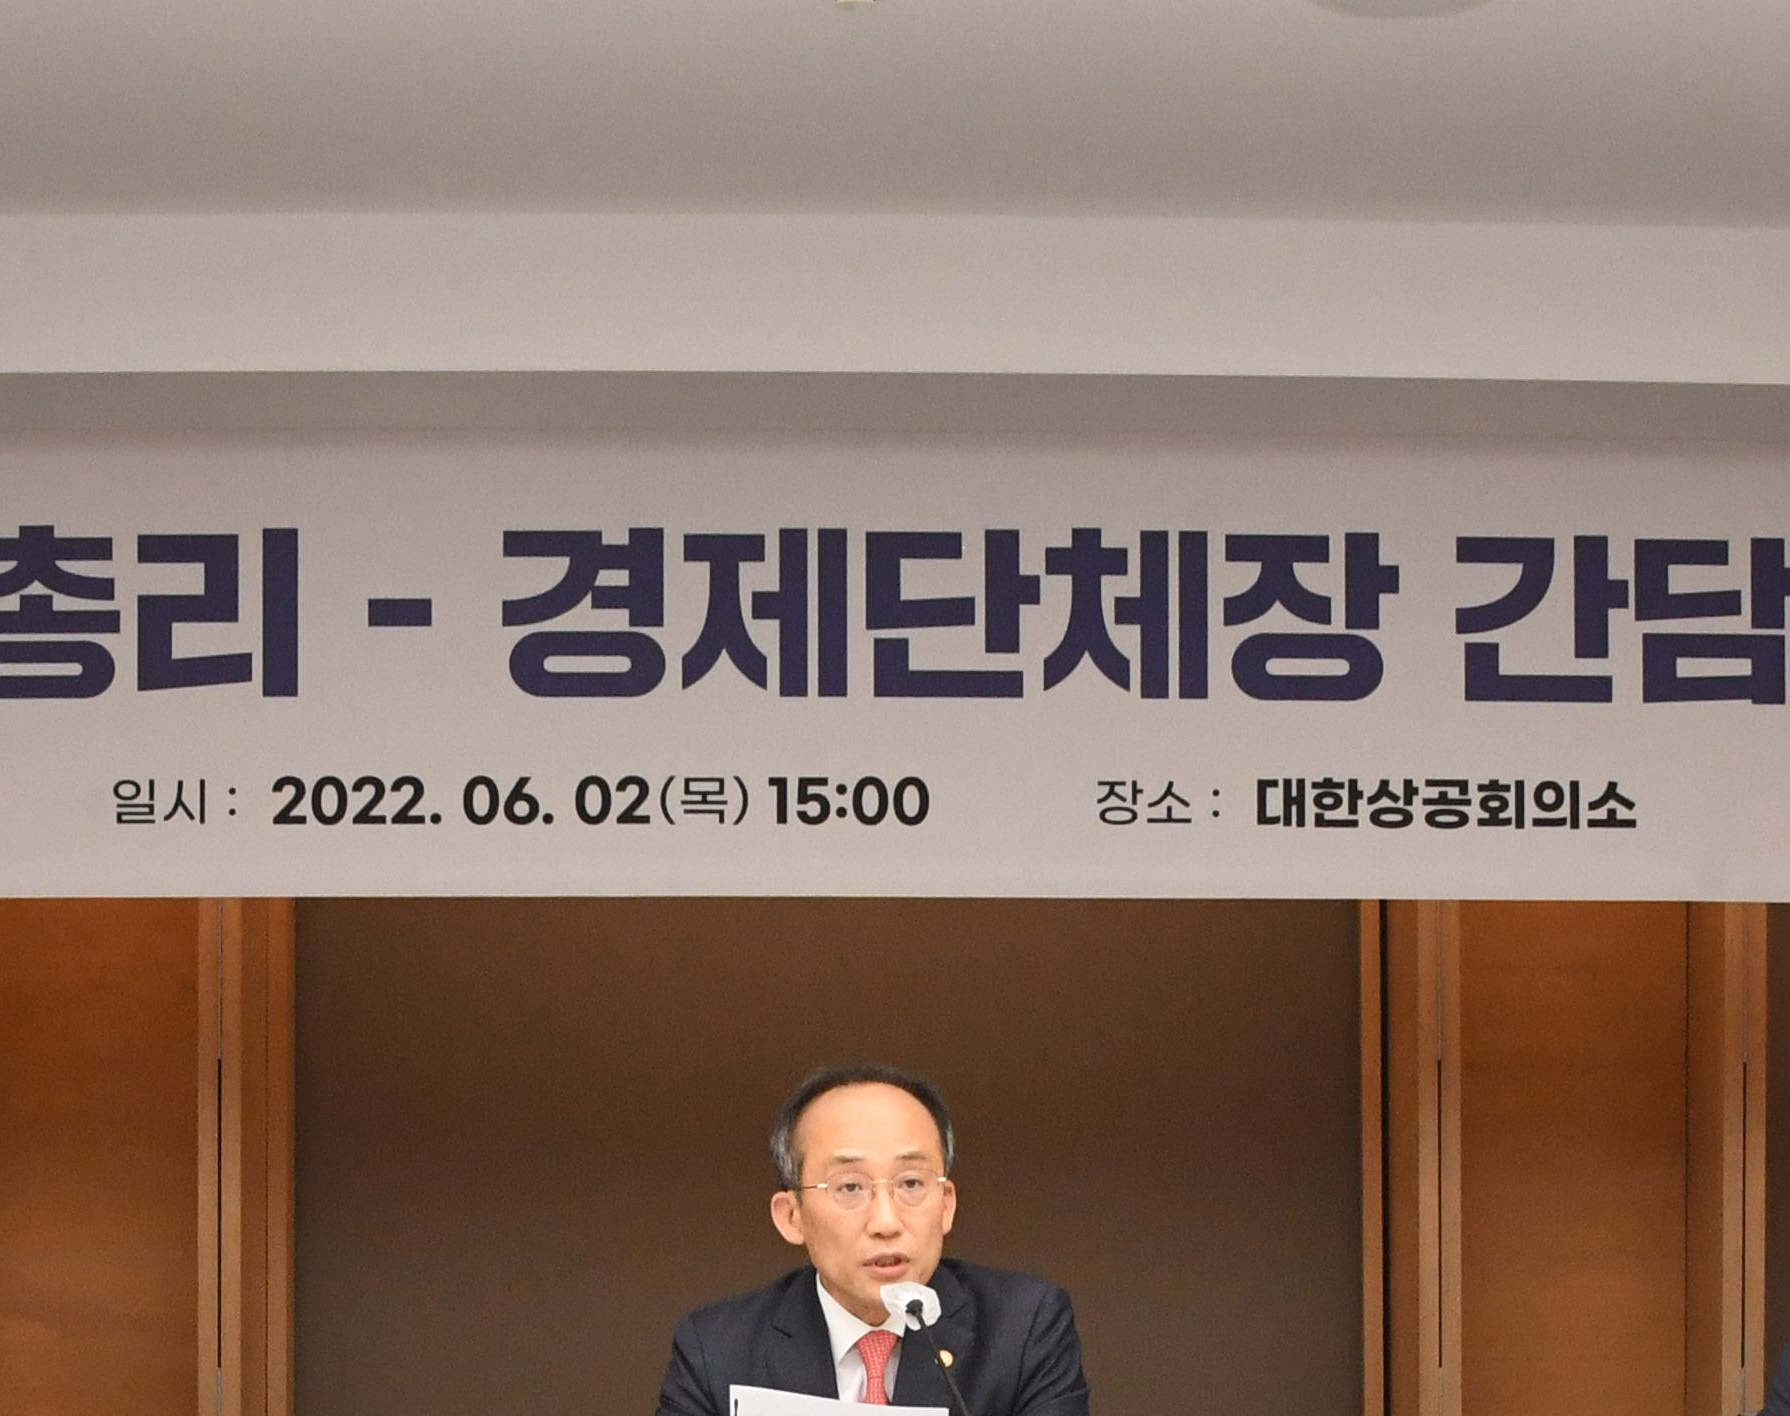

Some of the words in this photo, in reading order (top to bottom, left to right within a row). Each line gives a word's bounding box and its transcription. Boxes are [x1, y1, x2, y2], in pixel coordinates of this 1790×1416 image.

[501, 527, 1400, 702] 경제단체장
[271, 775, 442, 826] 2022.
[462, 775, 554, 826] 06.
[768, 775, 930, 827] 15:00
[1256, 776, 1637, 830] 대한상공회의소
